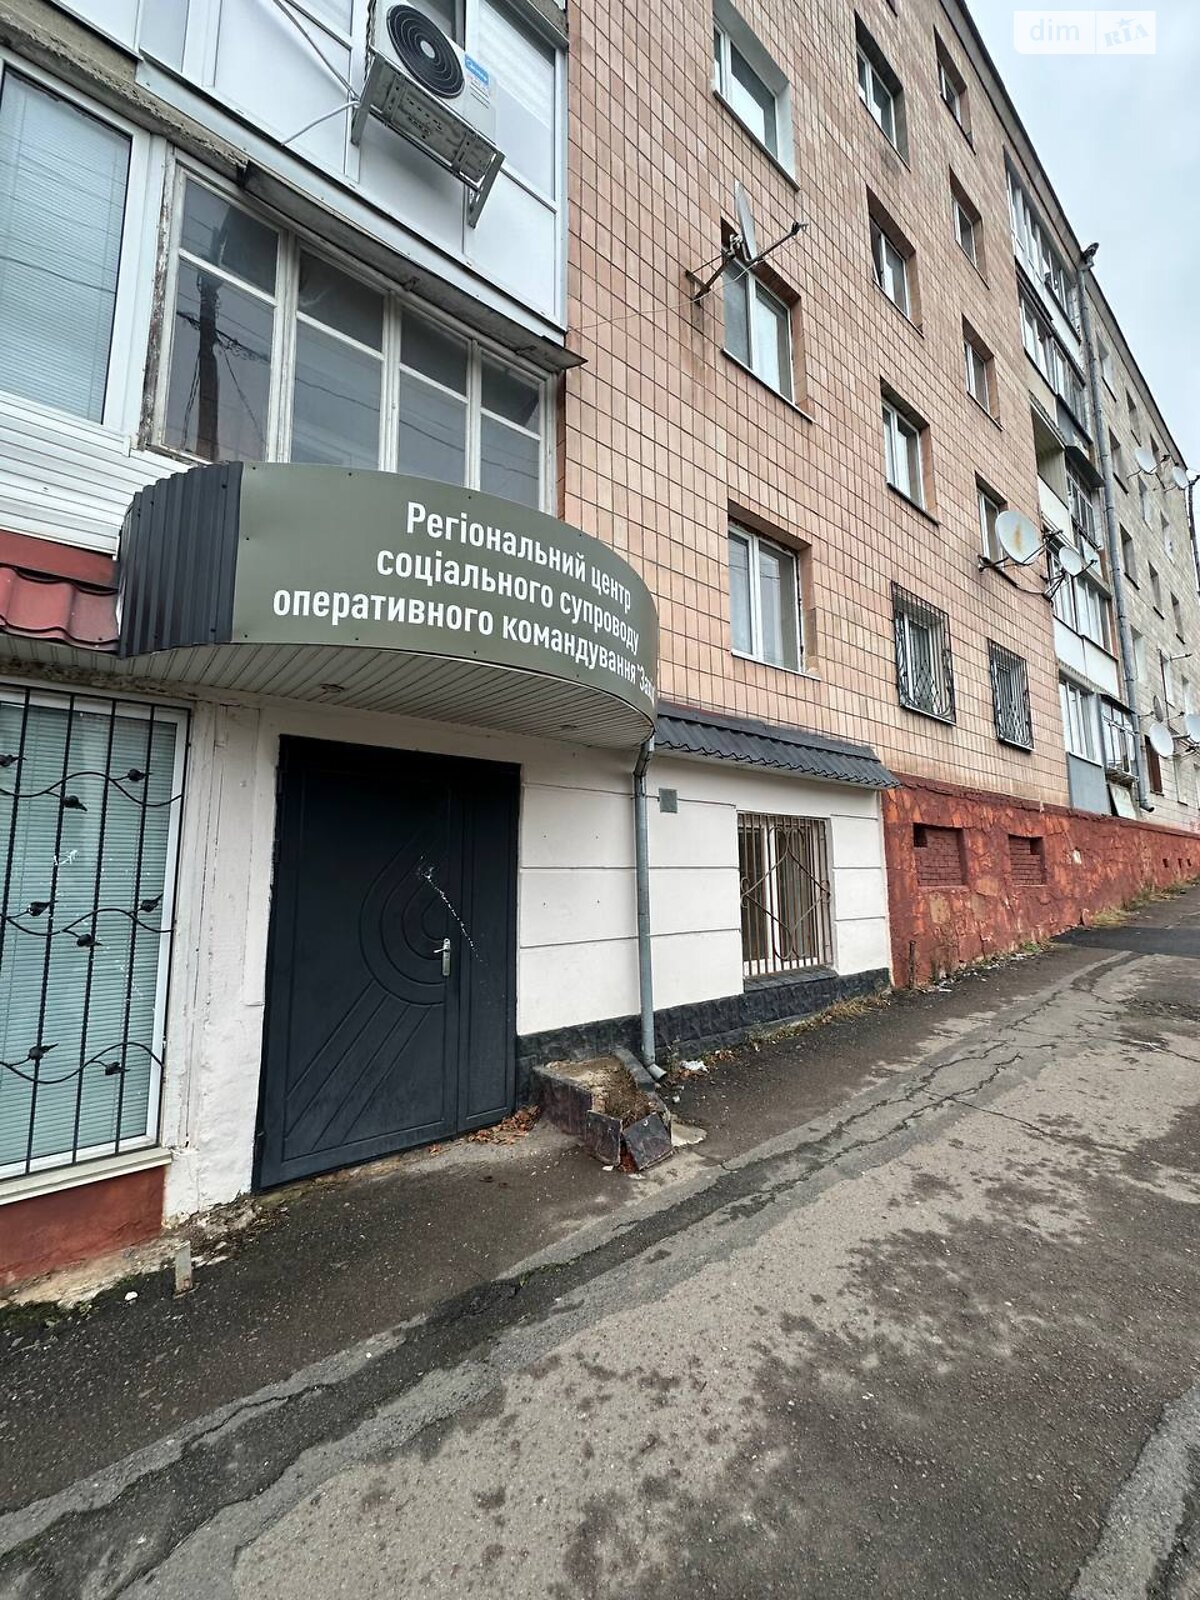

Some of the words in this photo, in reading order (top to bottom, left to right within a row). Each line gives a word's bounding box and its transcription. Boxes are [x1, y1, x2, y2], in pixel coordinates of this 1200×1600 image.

[376, 549, 554, 608] соціального
[559, 591, 639, 656] супроводу
[407, 501, 586, 582] Регіональний
[590, 566, 631, 614] центр
[272, 588, 494, 637] оперативного
[502, 616, 636, 685] командування
